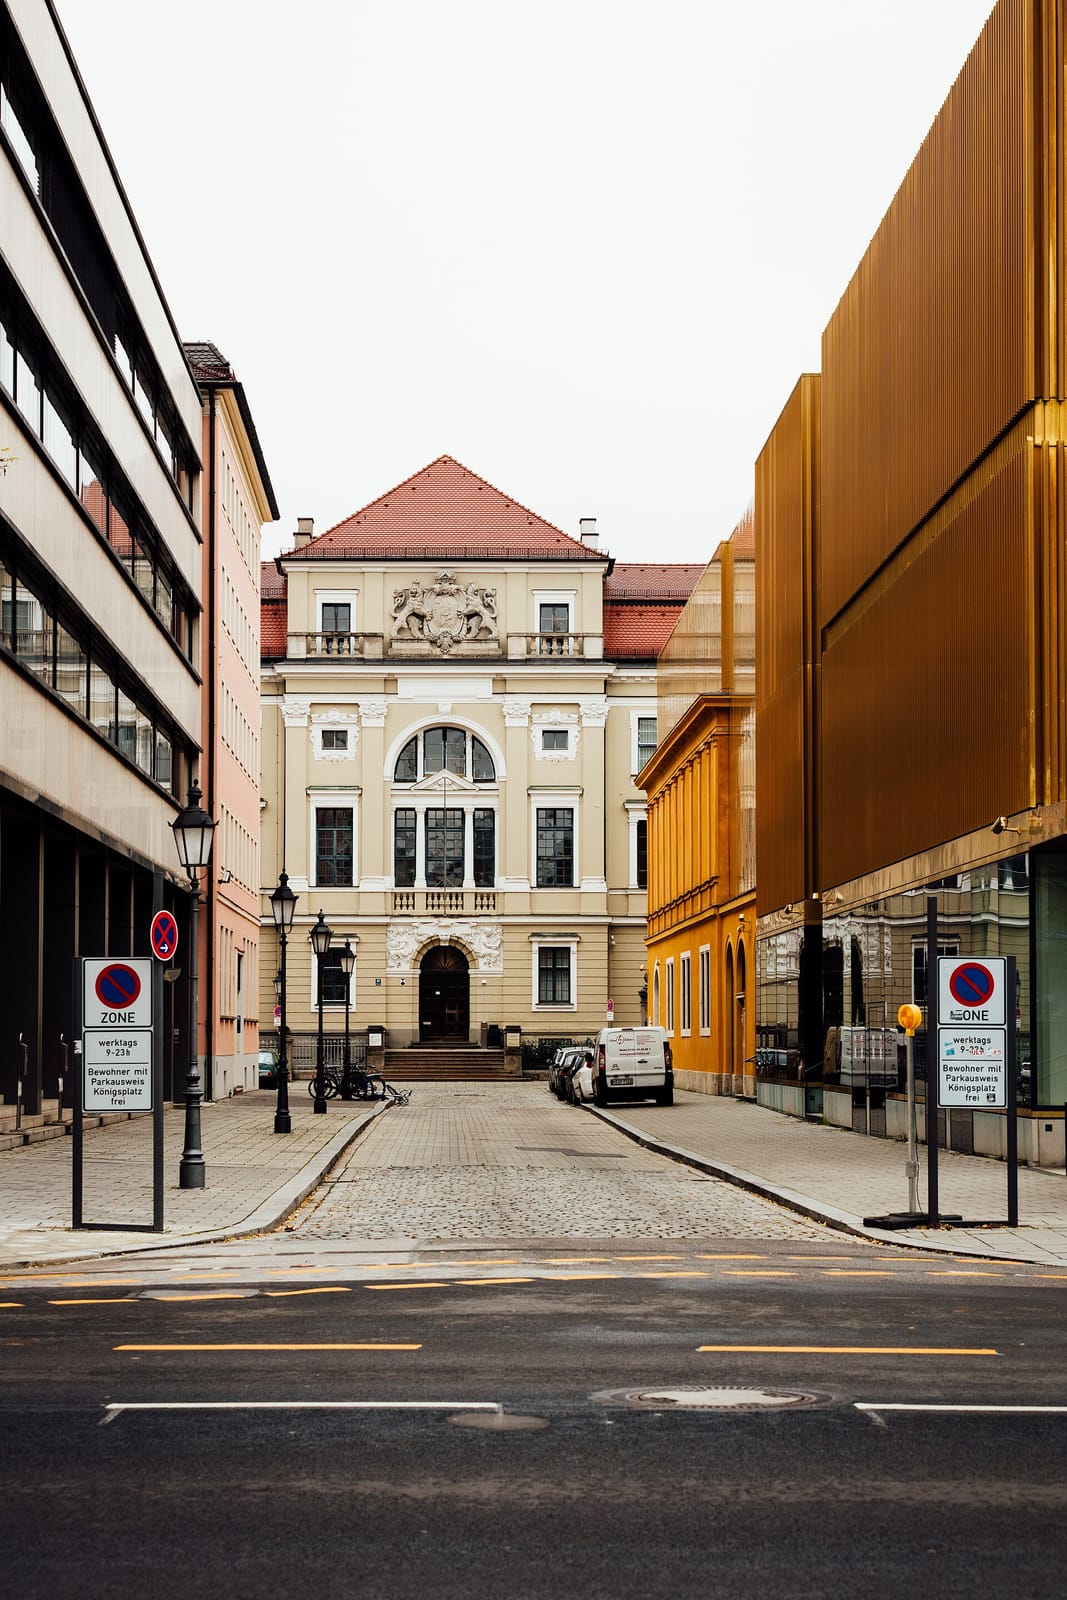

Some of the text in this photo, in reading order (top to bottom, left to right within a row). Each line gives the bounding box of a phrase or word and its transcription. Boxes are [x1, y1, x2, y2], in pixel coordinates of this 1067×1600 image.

[101, 1012, 135, 1023] ZONE
[98, 1039, 138, 1048] werktags
[953, 1036, 991, 1045] werktags
[88, 1067, 148, 1076] Bewohner mit
[942, 1064, 1002, 1073] Bewohner mit
[91, 1077, 145, 1087] Parkausweis
[945, 1074, 999, 1083] Parkausweis
[93, 1087, 143, 1098] Königsplatz
[948, 1083, 997, 1094] Königsplatz
[110, 1096, 126, 1106] frei
[965, 1093, 980, 1103] frei
